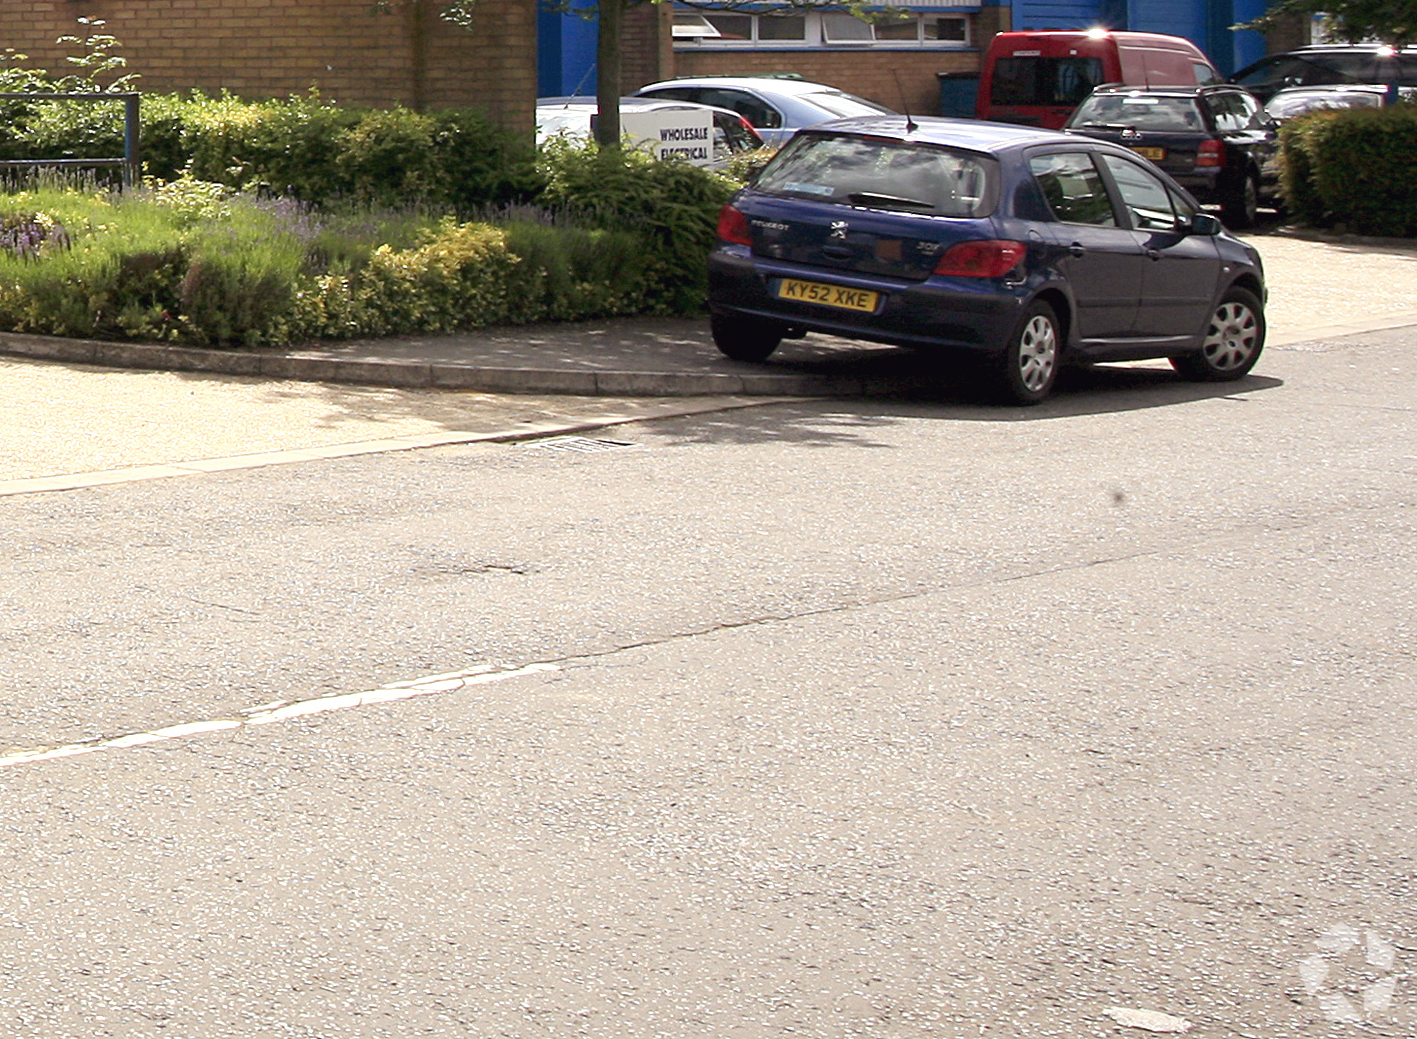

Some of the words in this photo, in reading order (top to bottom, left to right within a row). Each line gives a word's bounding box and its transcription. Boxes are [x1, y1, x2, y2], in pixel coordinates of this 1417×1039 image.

[660, 127, 708, 141] WHOLESALE
[786, 281, 830, 302] KY52
[833, 289, 869, 308] XKE
